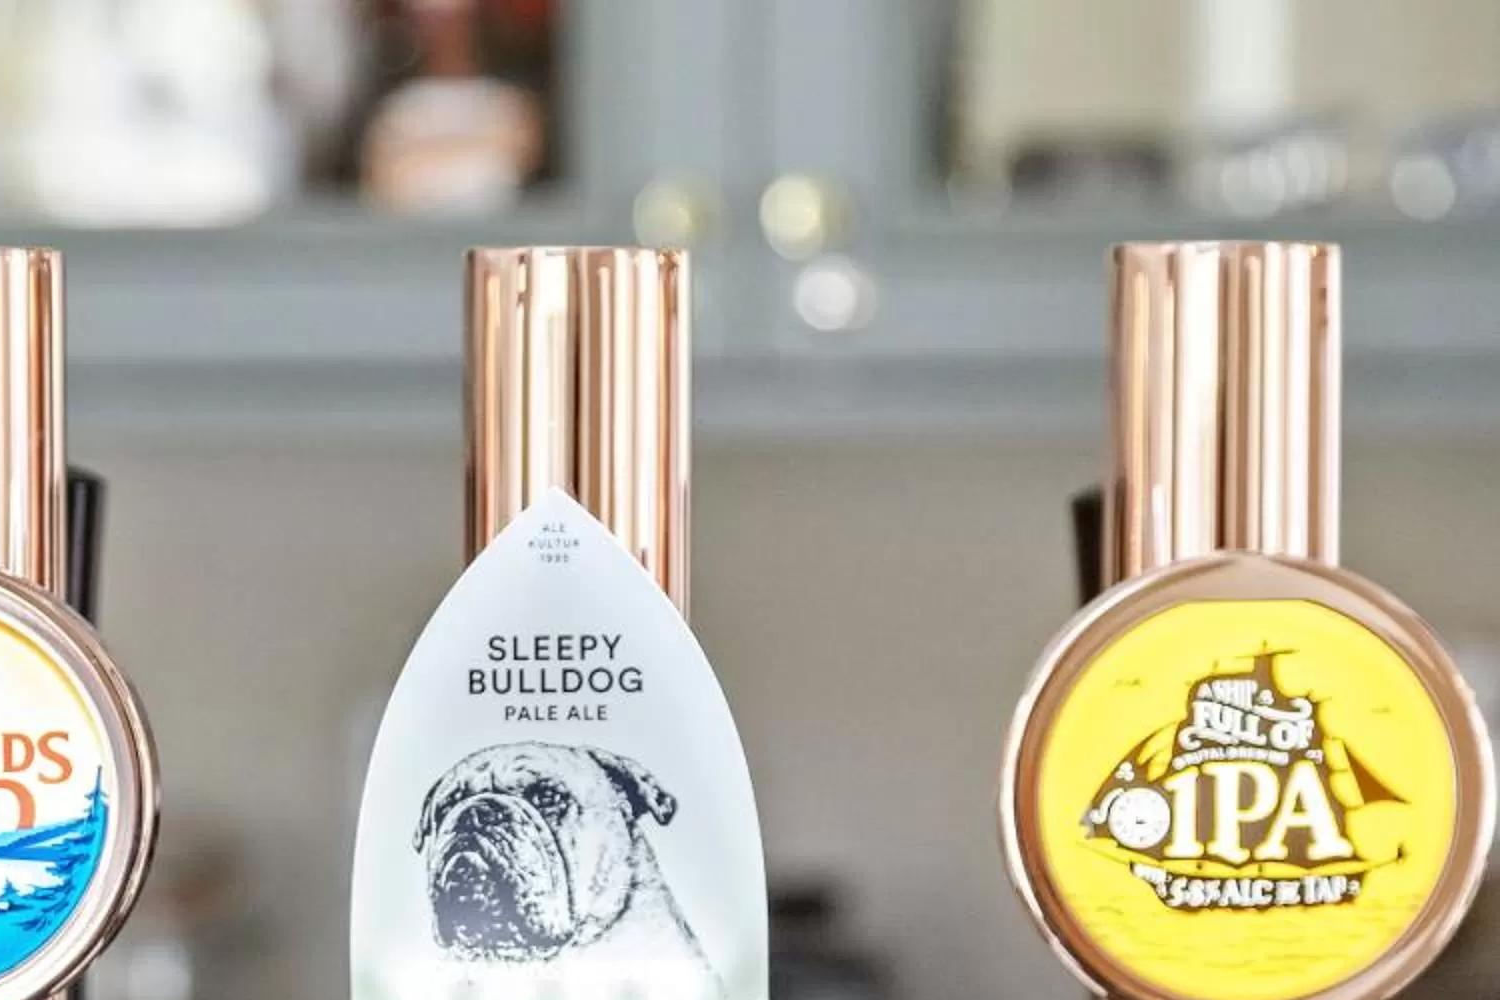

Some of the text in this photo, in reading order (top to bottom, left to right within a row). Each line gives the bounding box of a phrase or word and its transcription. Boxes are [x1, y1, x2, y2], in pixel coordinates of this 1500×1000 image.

[487, 634, 622, 662] SLEEPY
[468, 666, 644, 695] BULLDOG
[504, 704, 609, 722] PALE ALE
[1192, 700, 1315, 750] FULL OF
